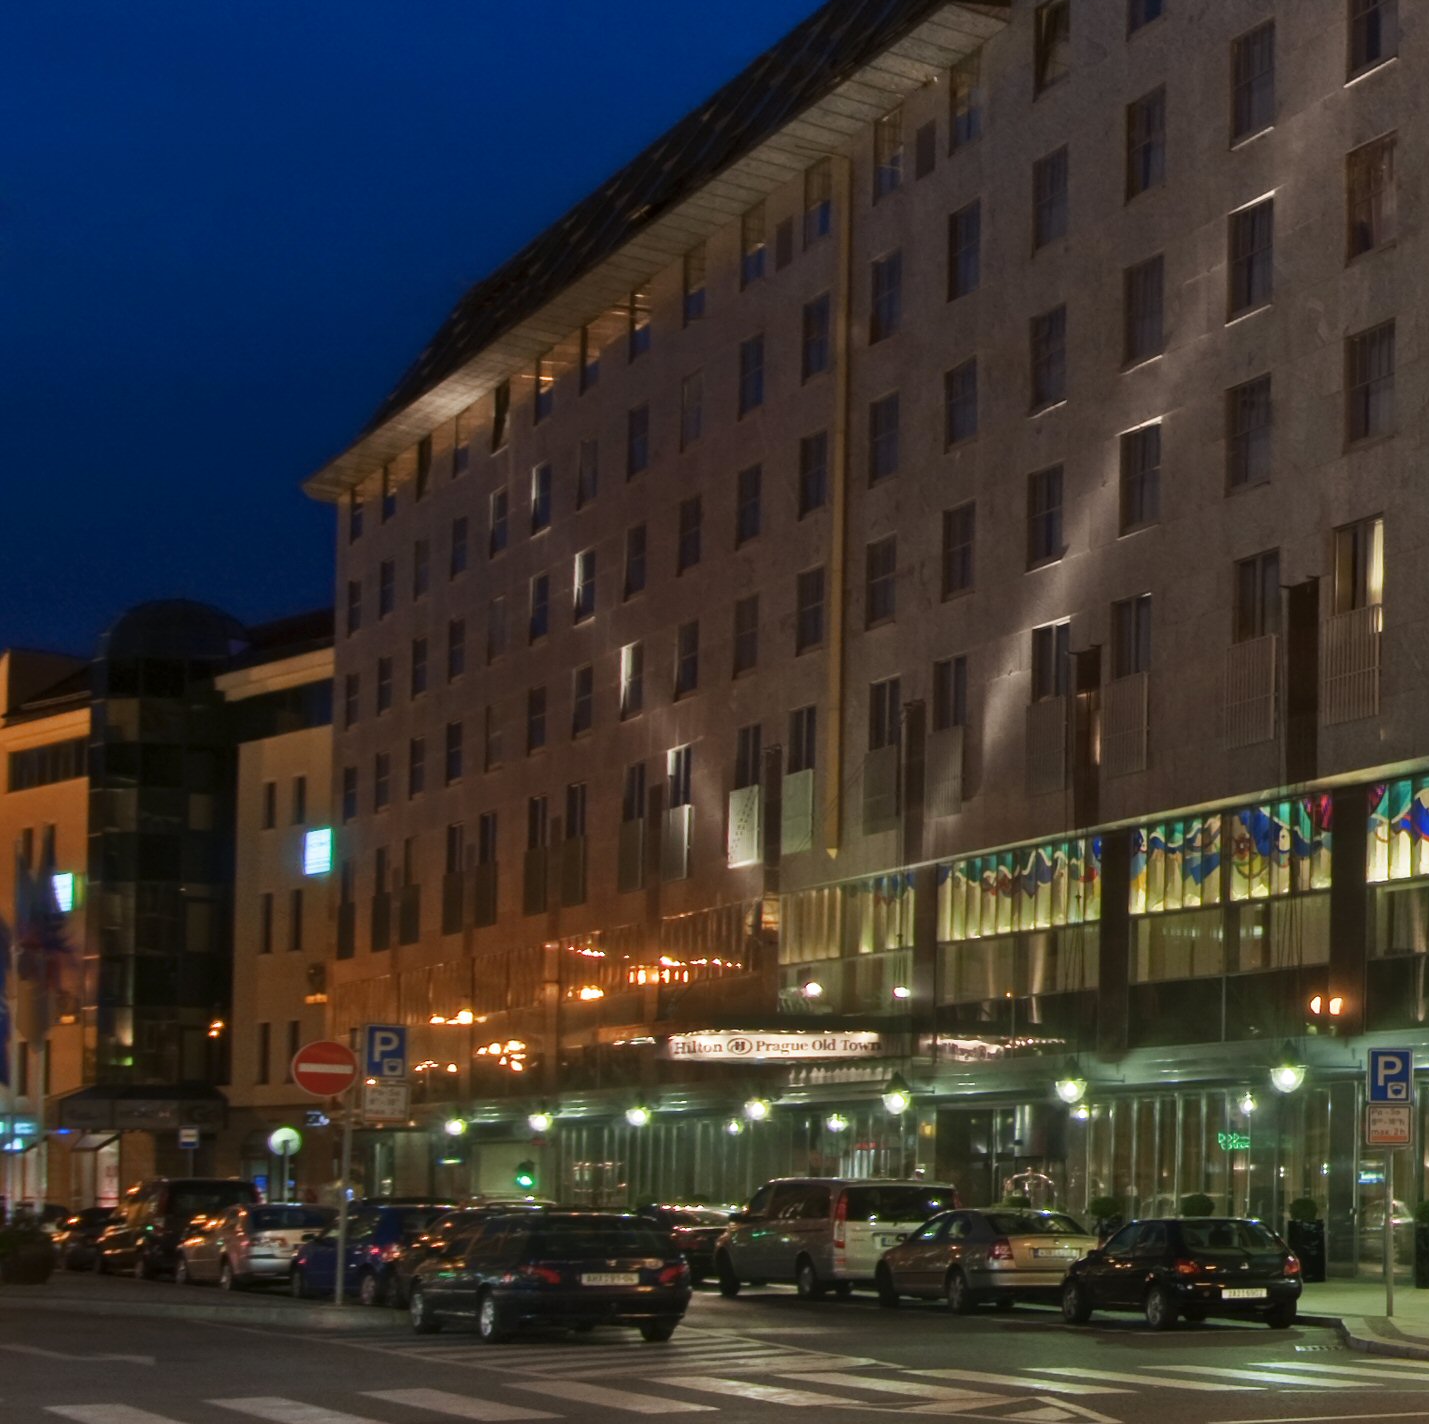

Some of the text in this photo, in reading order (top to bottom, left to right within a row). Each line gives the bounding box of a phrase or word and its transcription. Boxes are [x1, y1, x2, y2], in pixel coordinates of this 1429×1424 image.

[374, 1031, 399, 1062] P
[674, 1040, 723, 1055] Hilton
[756, 1040, 808, 1055] Prague
[812, 1039, 837, 1051] Old
[841, 1039, 883, 1051] Town
[1378, 1056, 1402, 1086] P
